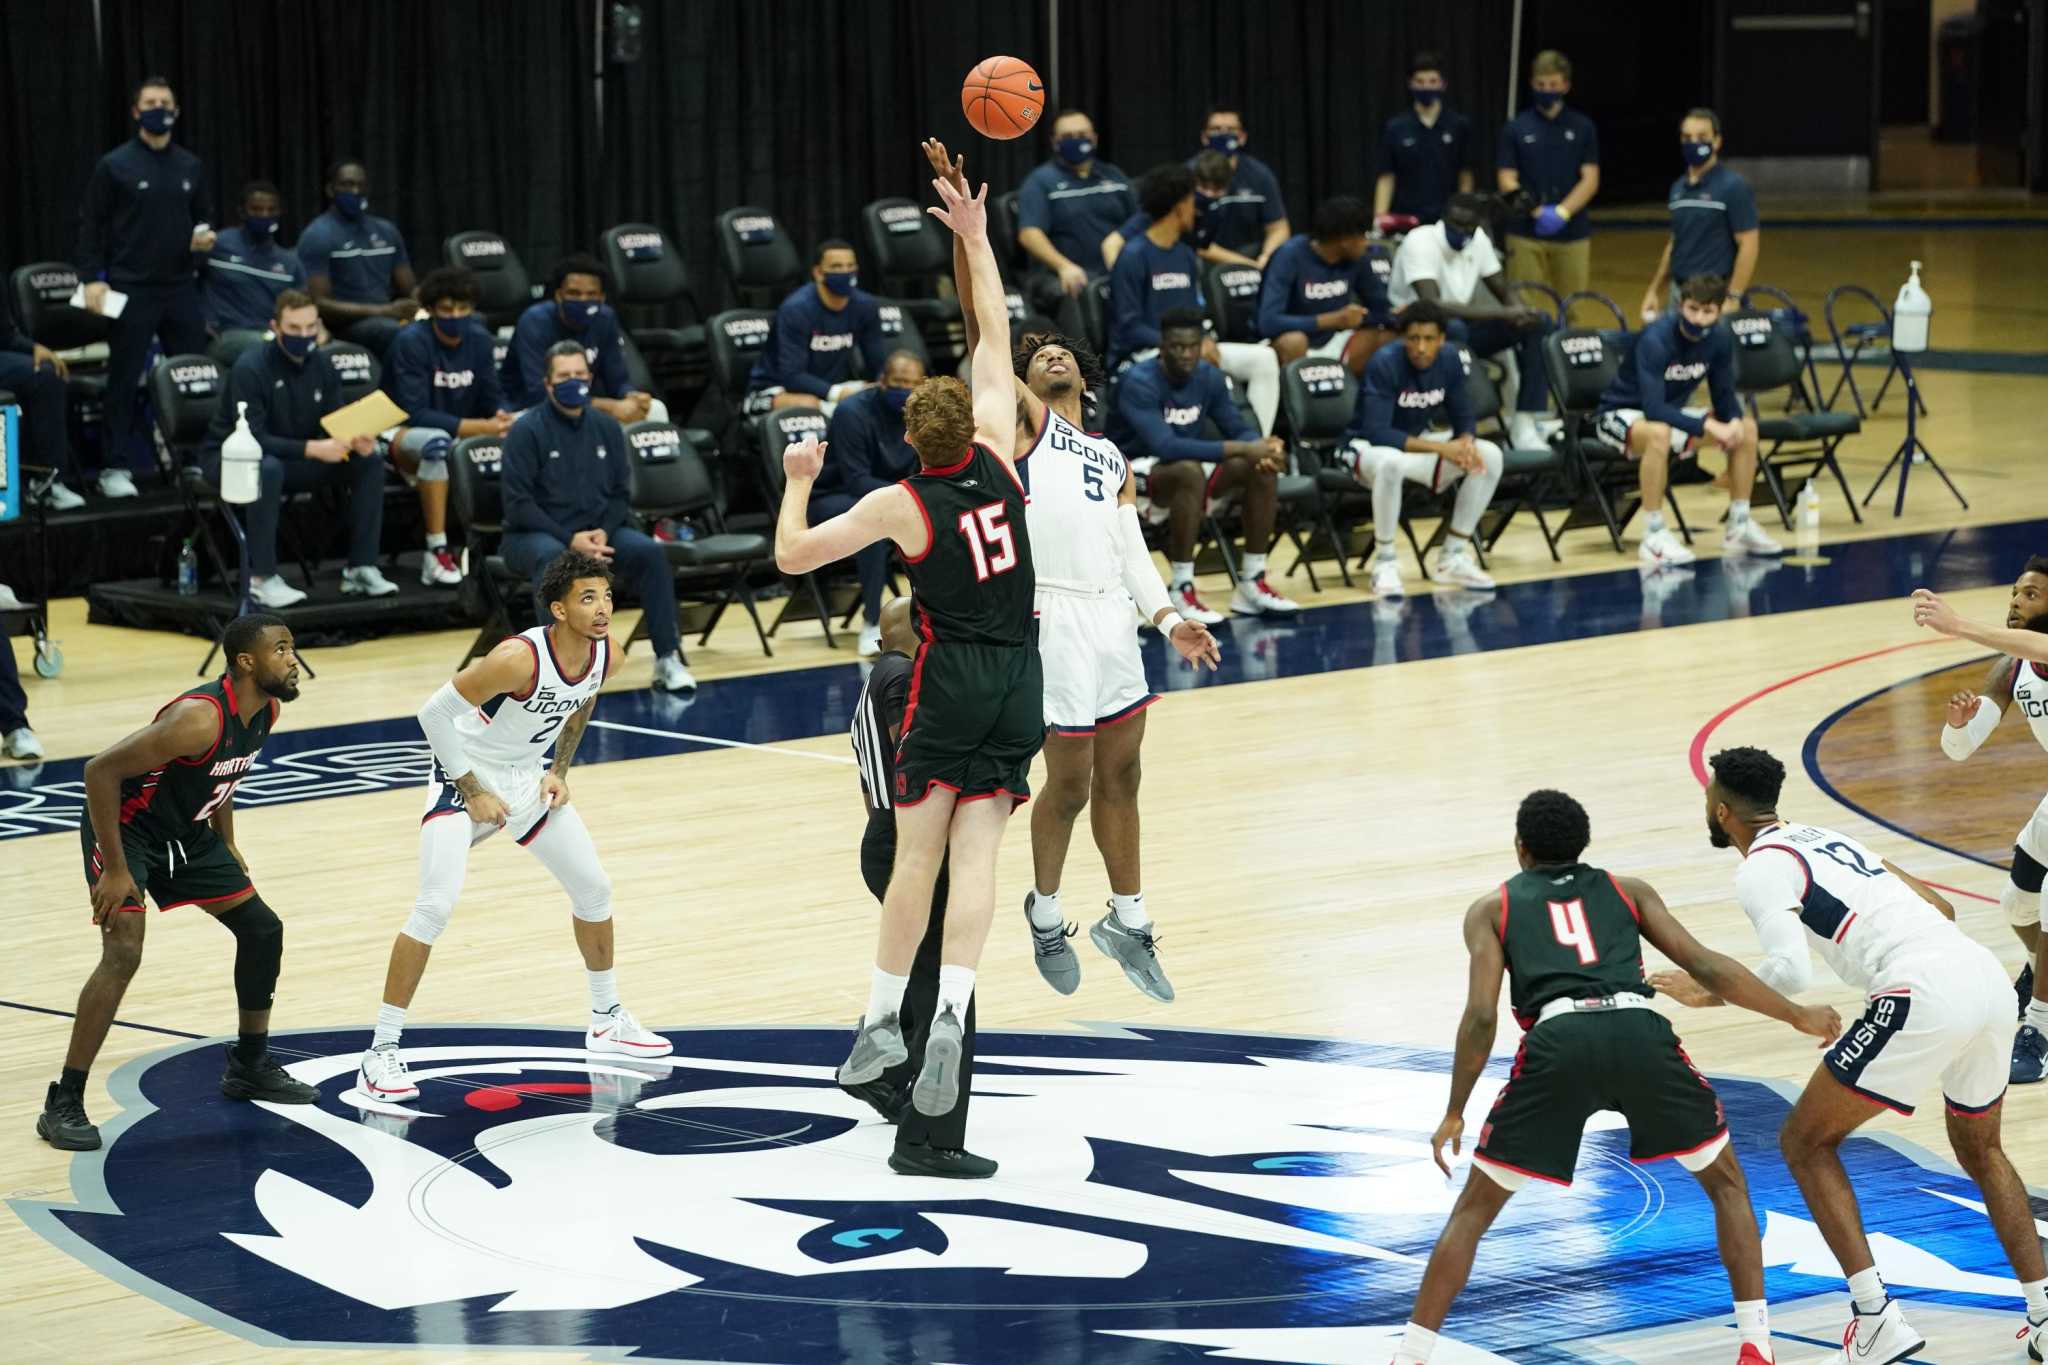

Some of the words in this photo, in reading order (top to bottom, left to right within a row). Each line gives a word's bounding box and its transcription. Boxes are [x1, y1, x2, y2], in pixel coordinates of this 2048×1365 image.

[631, 430, 680, 449] UCONN
[1051, 433, 1126, 482] UCONN
[1082, 463, 1105, 502] 5
[959, 498, 1017, 582] 15
[529, 716, 563, 744] 2
[1813, 841, 1888, 878] 12
[1547, 896, 1600, 967] 4
